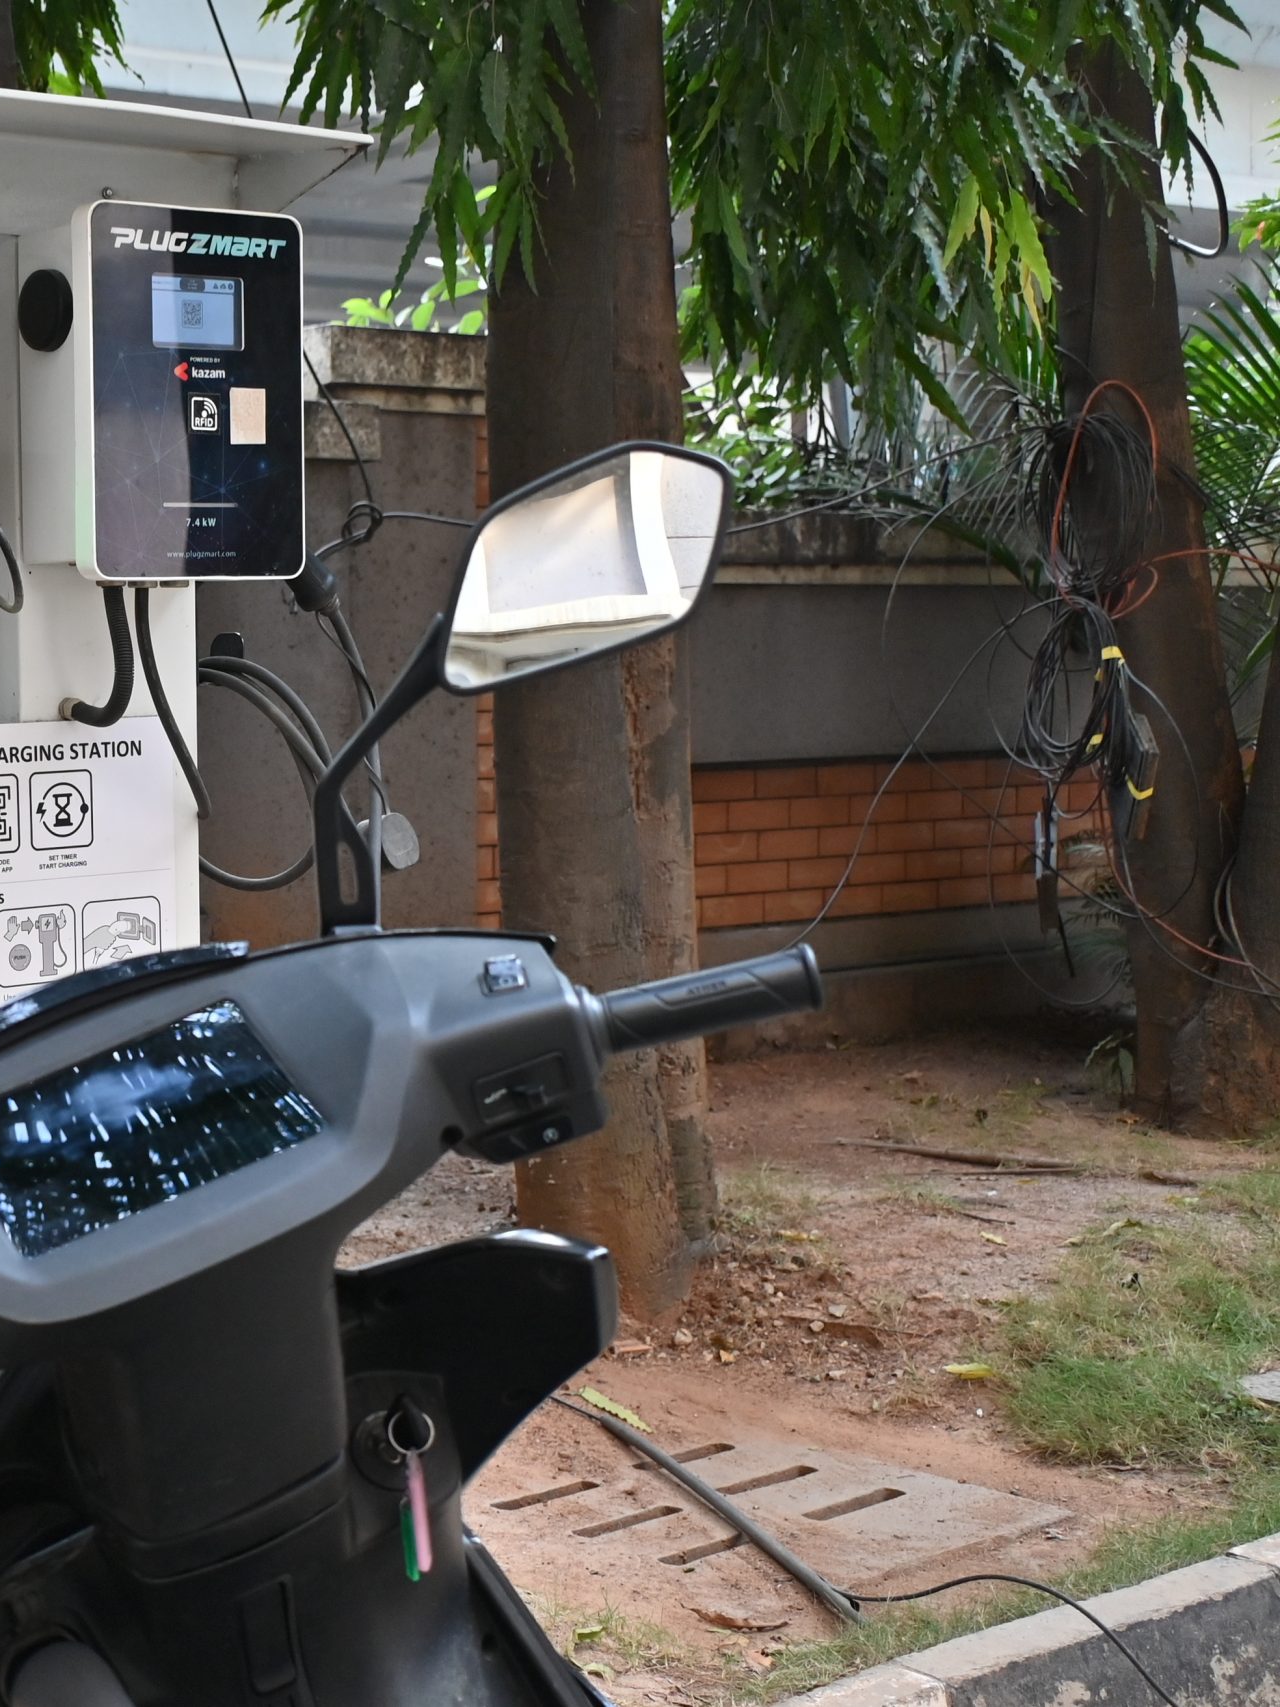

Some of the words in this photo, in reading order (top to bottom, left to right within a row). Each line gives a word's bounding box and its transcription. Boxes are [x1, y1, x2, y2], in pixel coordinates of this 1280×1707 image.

[191, 366, 226, 379] kazam
[194, 417, 214, 427] RFID
[186, 517, 200, 527] 7.4
[202, 517, 217, 527] kW
[166, 550, 237, 560] www.plugzmart.com
[70, 740, 142, 760] STATION
[58, 860, 87, 868] CHARGING
